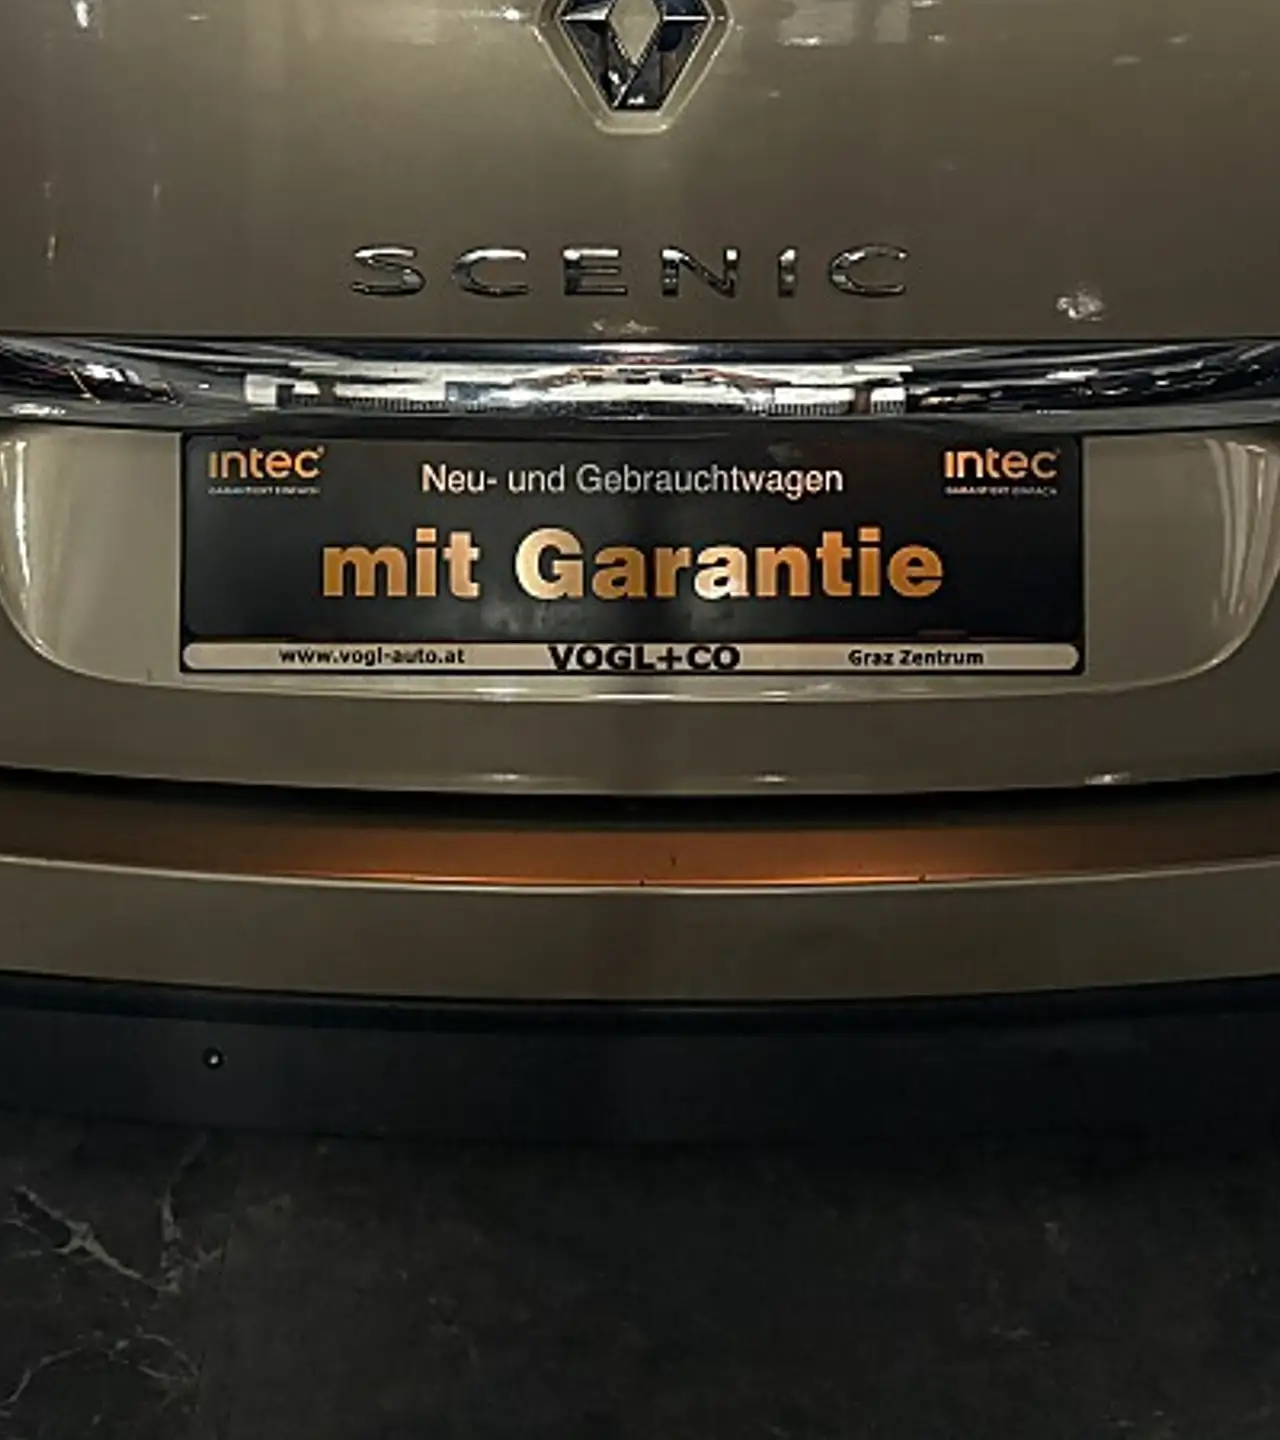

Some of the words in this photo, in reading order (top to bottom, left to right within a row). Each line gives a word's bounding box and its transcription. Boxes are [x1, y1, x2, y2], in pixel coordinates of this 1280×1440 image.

[352, 244, 908, 298] SCENIC
[208, 446, 321, 478] intec
[943, 447, 1058, 478] intec
[421, 463, 497, 493] Neu-
[507, 463, 566, 493] und
[576, 463, 844, 501] Gebrauchtwagen
[321, 527, 480, 598] mit
[515, 527, 944, 600] Garantie
[278, 646, 466, 667] www.vogl-auto.at
[548, 645, 741, 671] VOGL+CO
[847, 649, 894, 667] Graz
[899, 649, 984, 667] Zentrum
